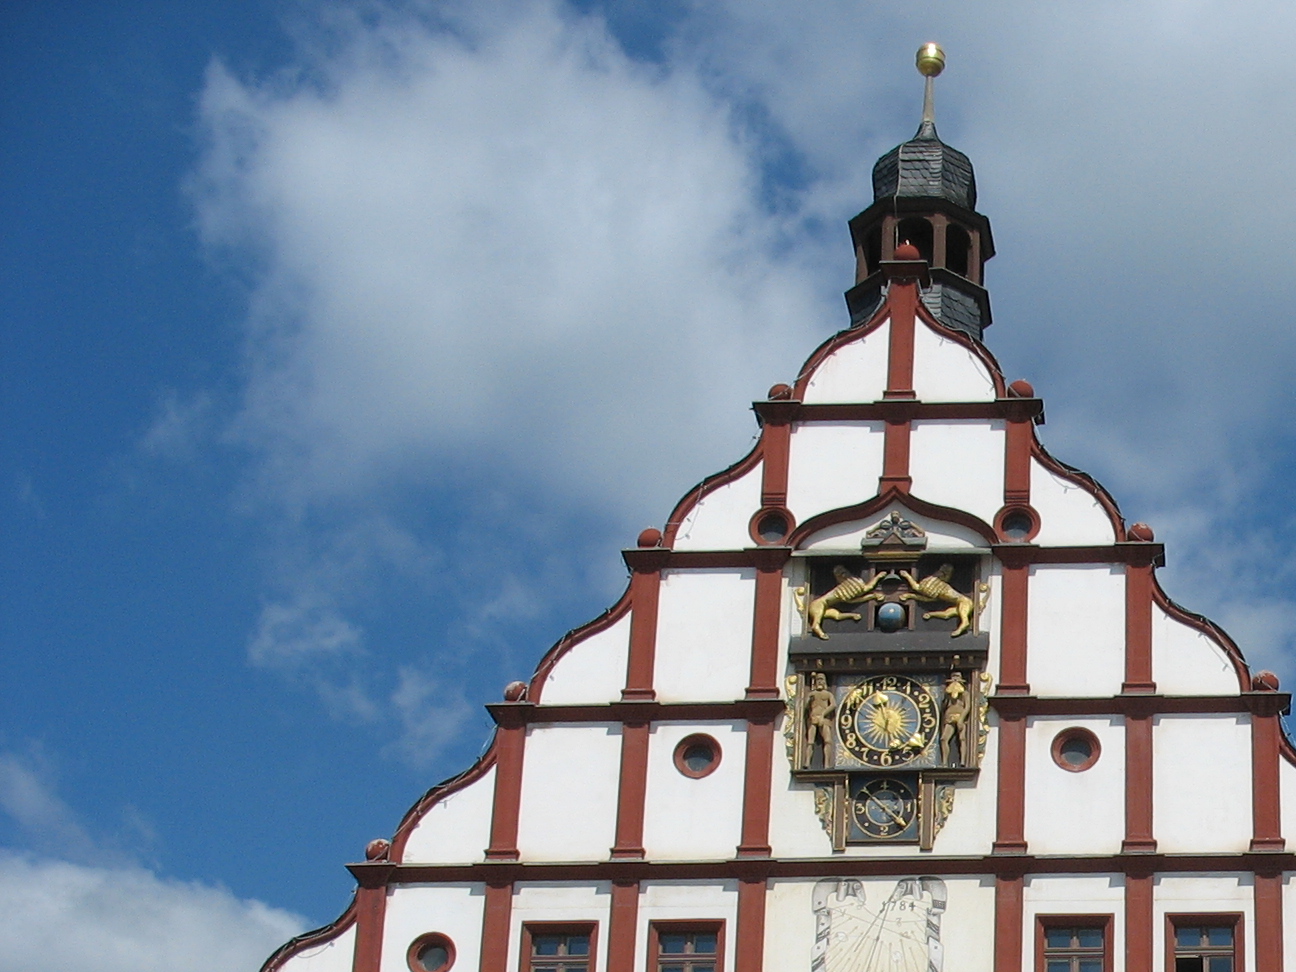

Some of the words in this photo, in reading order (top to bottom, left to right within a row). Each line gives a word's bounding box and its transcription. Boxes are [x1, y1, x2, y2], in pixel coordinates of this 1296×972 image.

[861, 682, 874, 695] 11
[881, 677, 897, 690] 12
[919, 693, 930, 708] 2
[841, 714, 852, 729] 9
[923, 713, 935, 728] 3
[846, 733, 856, 749] 8
[881, 752, 892, 767] 6
[855, 803, 865, 815] 3
[880, 826, 889, 836] 2
